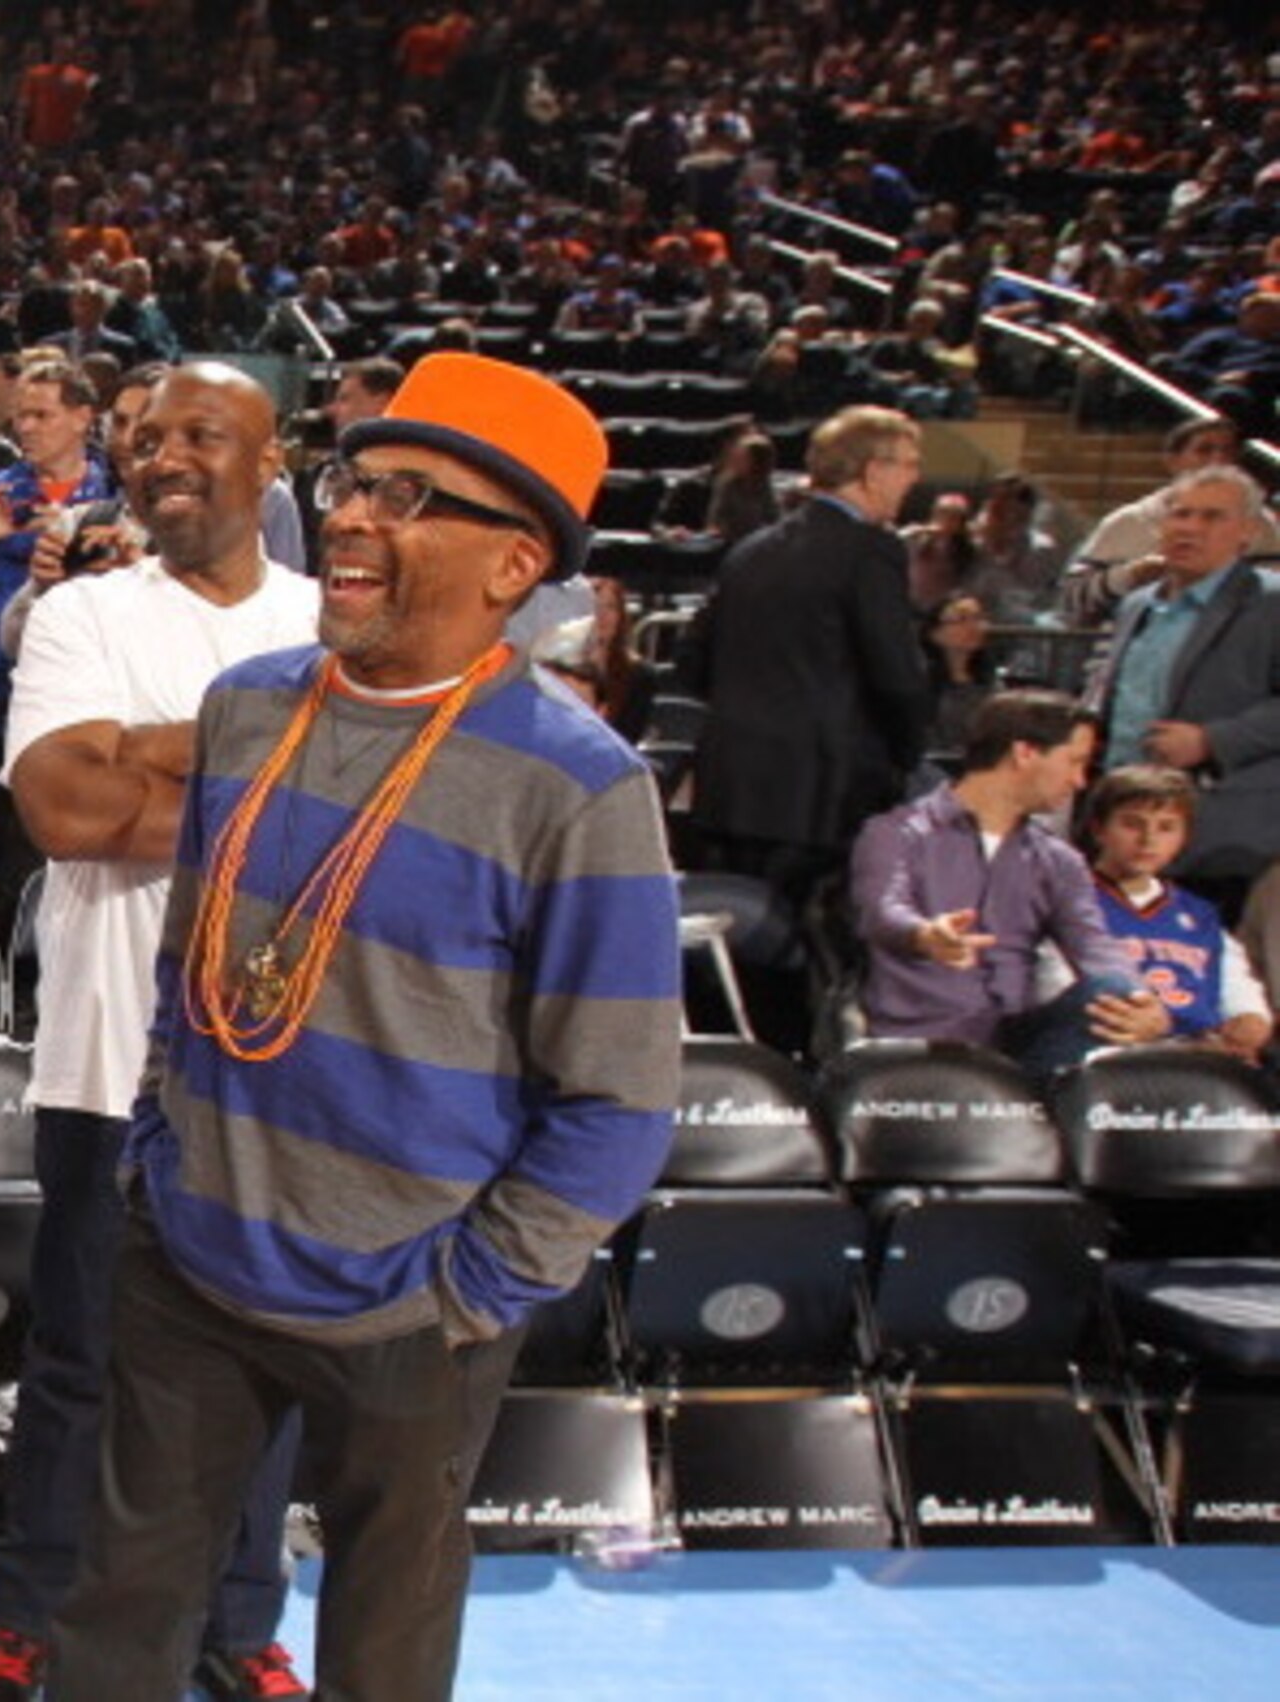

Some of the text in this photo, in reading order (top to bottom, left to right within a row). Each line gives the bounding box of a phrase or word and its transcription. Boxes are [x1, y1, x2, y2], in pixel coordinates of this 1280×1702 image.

[686, 1102, 704, 1126] &
[851, 1101, 1048, 1121] ANDREW MARC
[1162, 1109, 1178, 1130] &
[512, 1503, 530, 1524] &
[682, 1506, 877, 1527] ANDREW MARC
[982, 1502, 997, 1523] &
[1193, 1503, 1280, 1521] ANDRE
